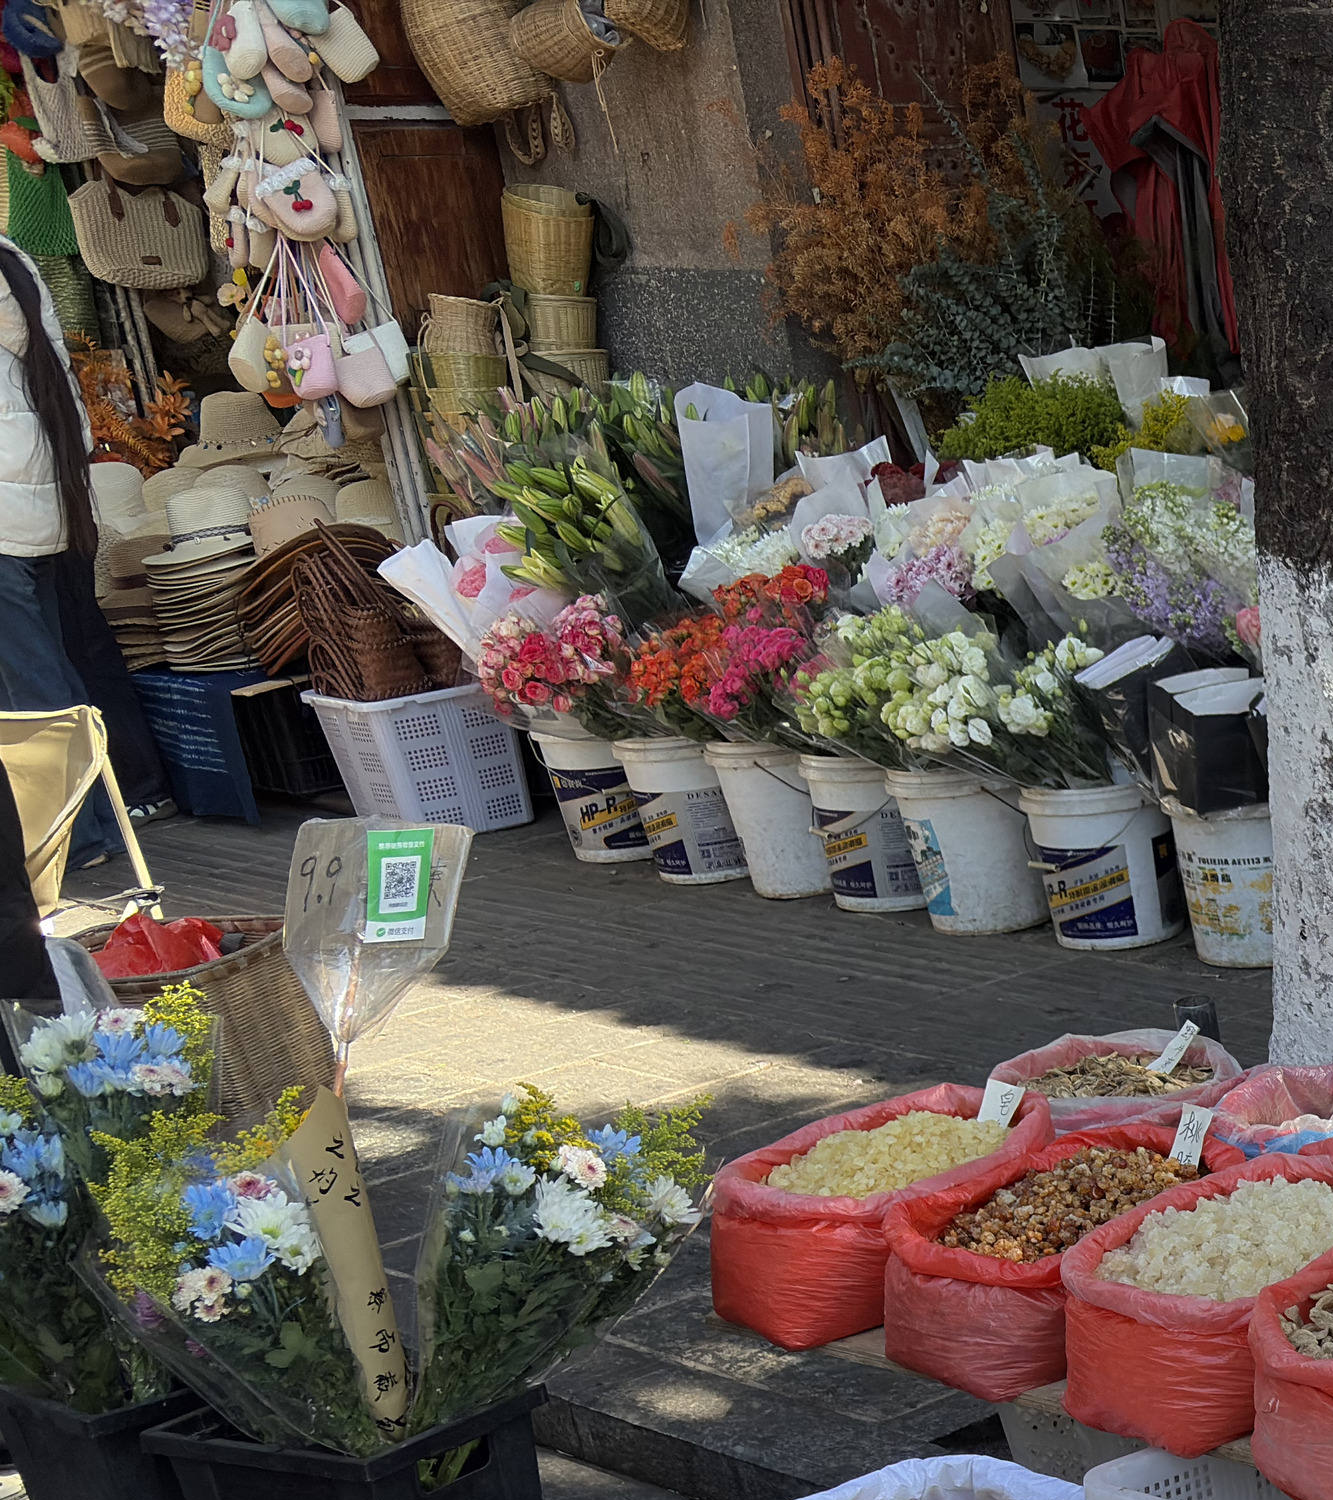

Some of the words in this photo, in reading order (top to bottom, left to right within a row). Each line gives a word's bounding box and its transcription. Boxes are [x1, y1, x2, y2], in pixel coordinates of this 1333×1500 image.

[300, 856, 342, 913] 9.9
[387, 926, 415, 936] 微信支付
